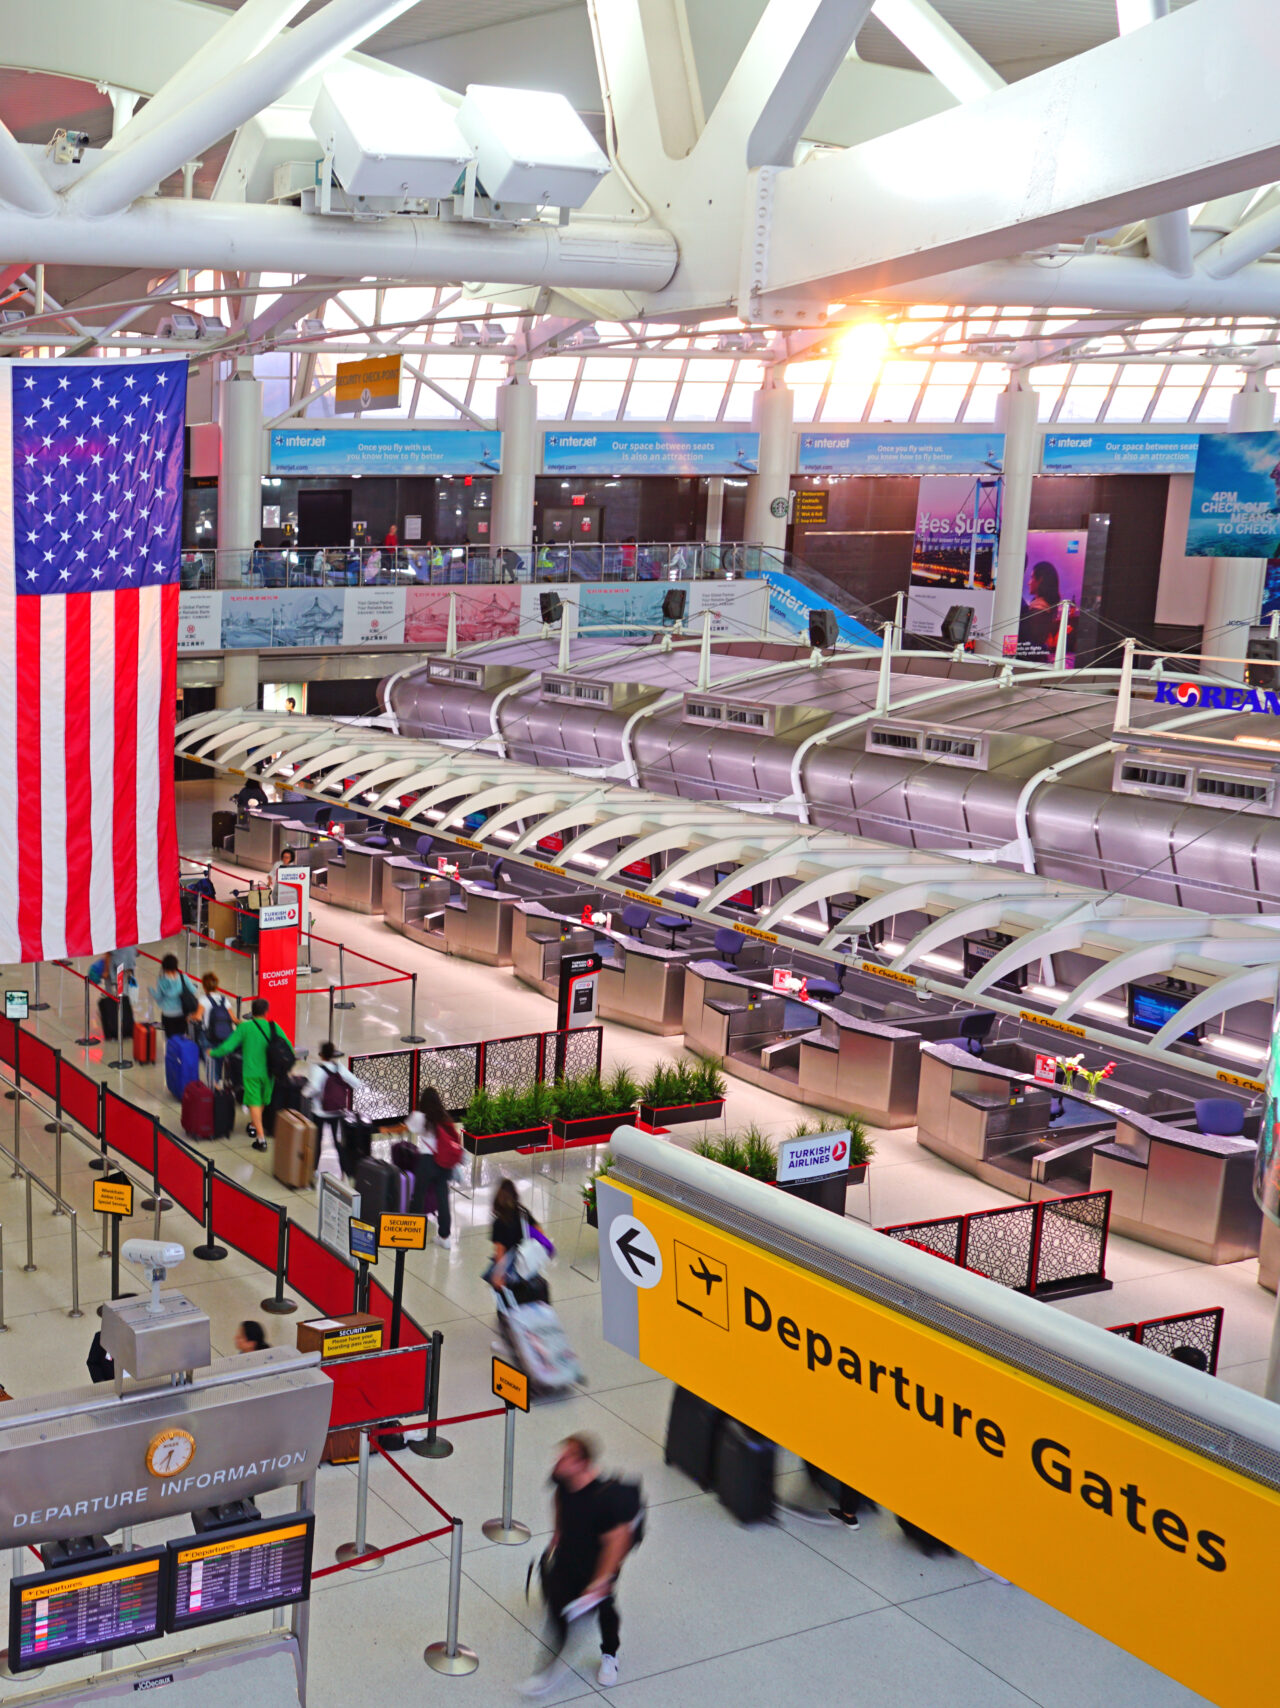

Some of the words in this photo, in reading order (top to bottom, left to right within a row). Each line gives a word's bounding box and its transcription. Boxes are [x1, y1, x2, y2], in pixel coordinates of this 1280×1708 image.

[337, 374, 361, 386] SECURITY
[286, 436, 326, 447] interjet
[559, 436, 598, 447] interjet
[612, 442, 628, 450] Our
[630, 443, 654, 452] space
[655, 442, 691, 450] between
[692, 442, 715, 450] seats
[814, 438, 850, 449] interjet
[1058, 438, 1092, 448] interjet
[1106, 442, 1120, 450] Our
[1122, 443, 1144, 452] space
[1146, 442, 1178, 450] between
[358, 443, 376, 451] Once
[378, 445, 392, 453] you
[394, 444, 402, 452] fly
[910, 445, 918, 454] fly
[410, 452, 420, 461] fly
[622, 453, 628, 461] is
[630, 452, 648, 461] also
[662, 452, 704, 461] attraction
[1114, 452, 1120, 460] is
[1122, 452, 1139, 460] also
[1152, 452, 1190, 460] attraction
[1211, 491, 1238, 502] 4PM
[1217, 523, 1234, 534] TO
[1235, 523, 1278, 535] CHECK
[262, 968, 295, 980] ECONOMY
[268, 978, 288, 988] CLASS
[790, 1145, 830, 1159] TURKISH
[788, 1154, 830, 1168] AIRLINES
[339, 1327, 367, 1337] SECURITY
[500, 1376, 521, 1392] ECONOMY
[744, 1285, 1006, 1458] Departure
[1030, 1437, 1228, 1573] Gates
[13, 1487, 148, 1528] DEPARTURE
[160, 1450, 308, 1497] INFORMATION
[192, 1544, 235, 1558] Departures
[36, 1580, 83, 1596] Departures
[138, 1676, 170, 1690] JCDecaux
